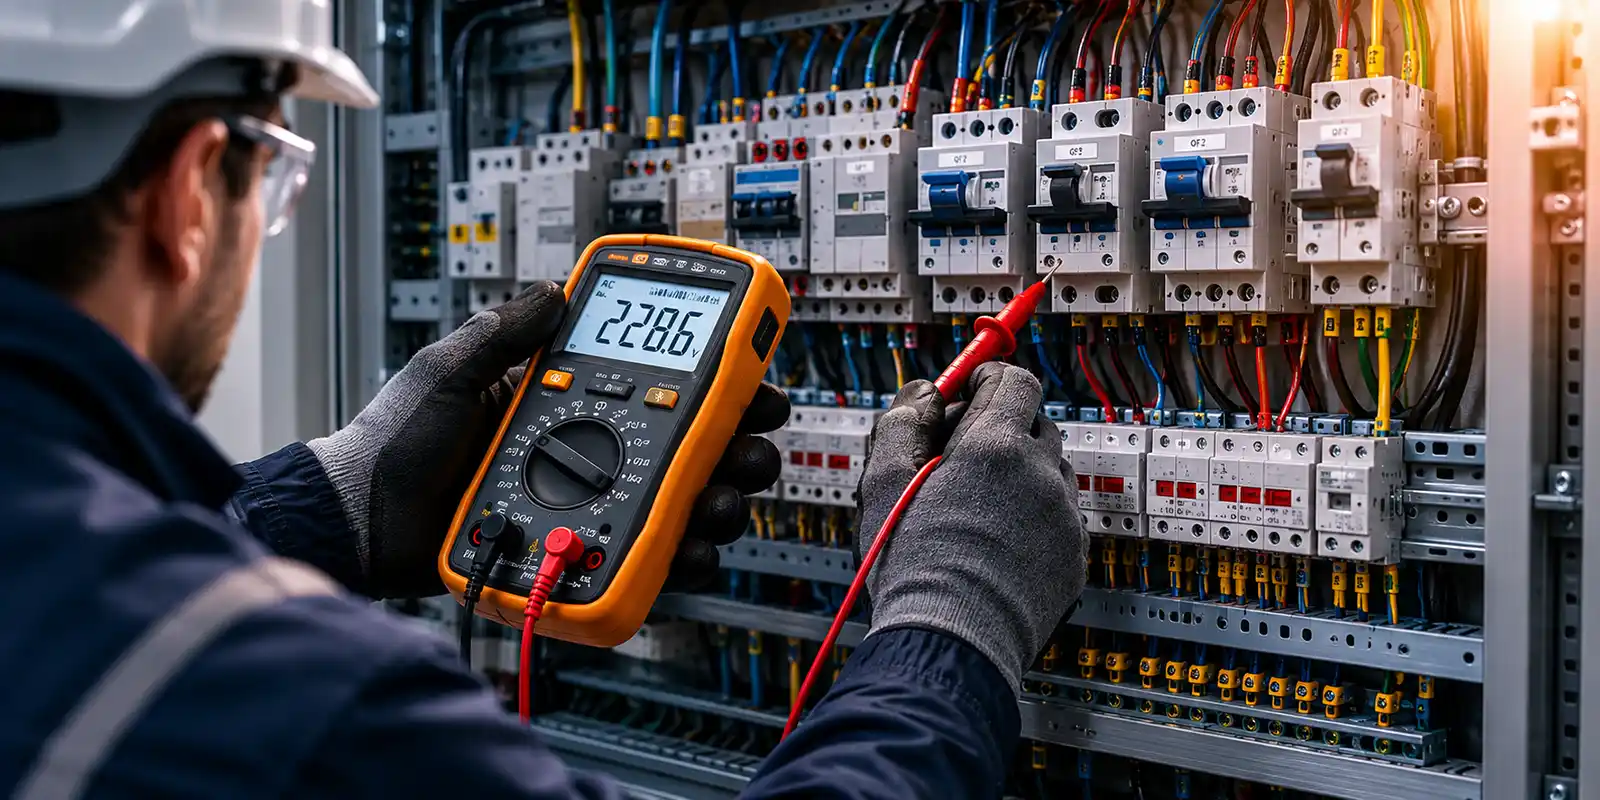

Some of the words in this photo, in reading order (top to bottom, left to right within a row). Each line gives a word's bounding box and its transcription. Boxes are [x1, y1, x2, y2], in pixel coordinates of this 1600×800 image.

[600, 279, 615, 290] AC
[595, 299, 704, 356] 228.6
[691, 348, 701, 358] V
